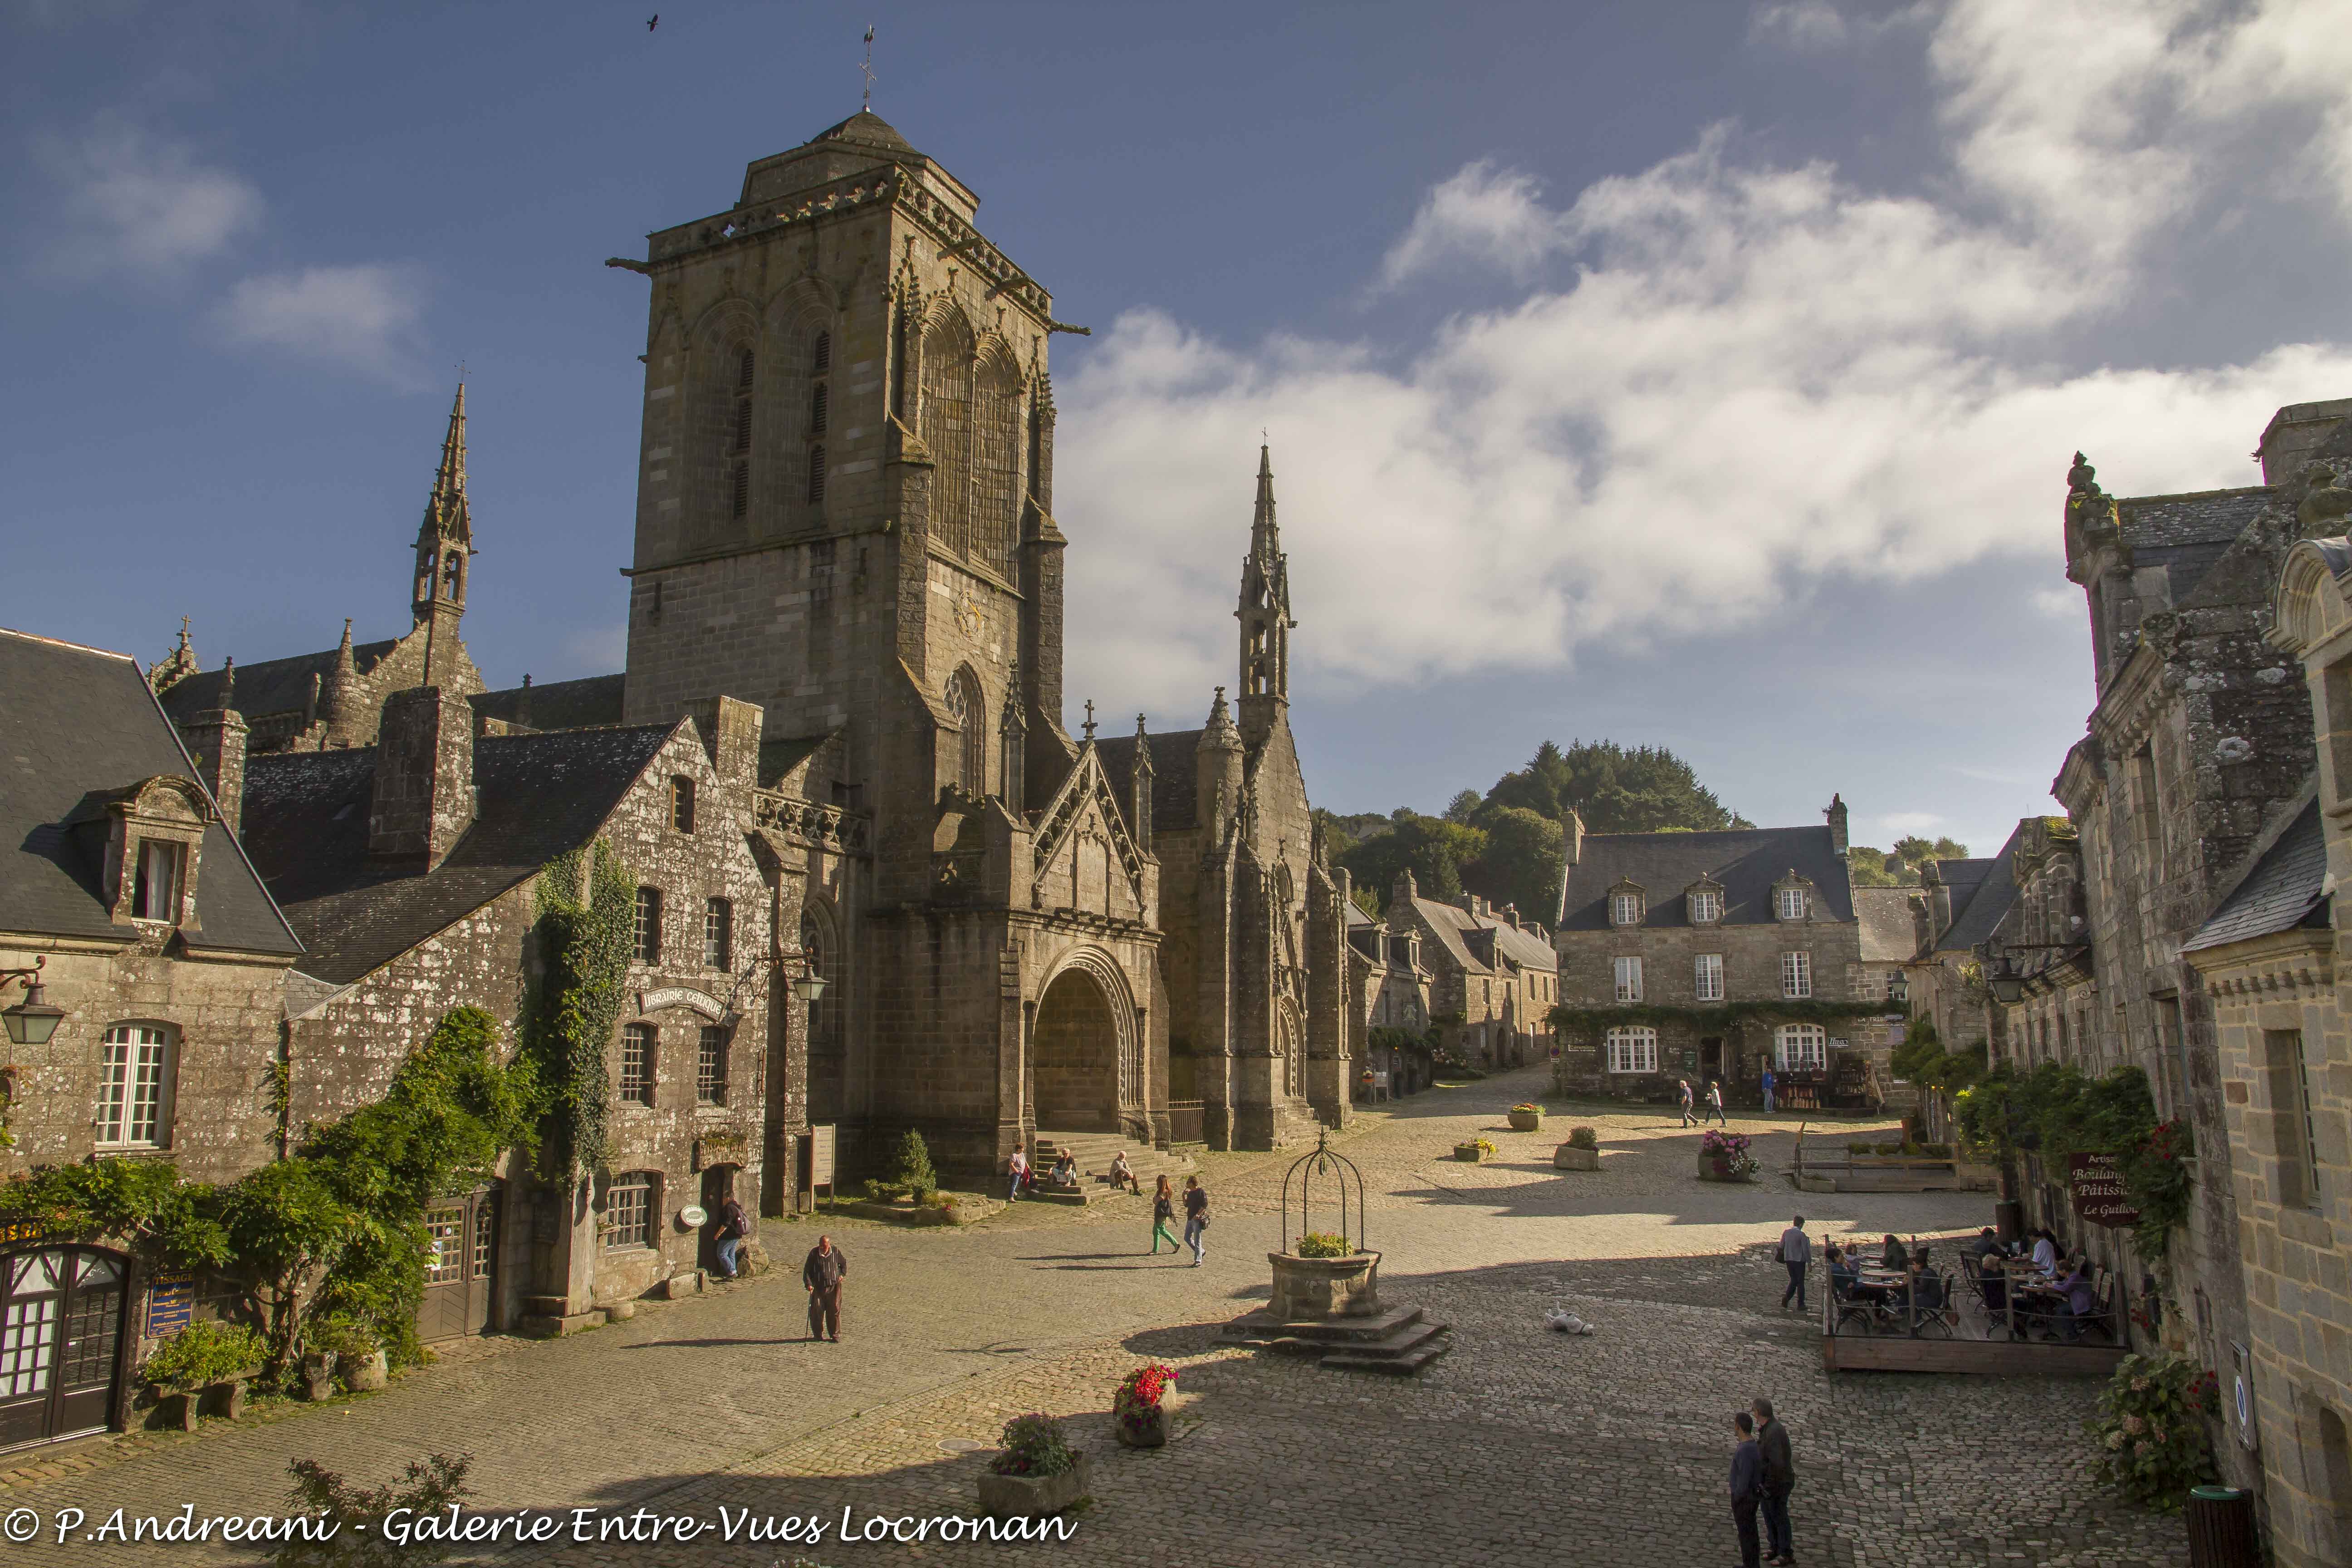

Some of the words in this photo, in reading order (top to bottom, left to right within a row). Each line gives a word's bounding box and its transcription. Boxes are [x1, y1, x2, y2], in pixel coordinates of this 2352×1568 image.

[2073, 1166, 2127, 1184] Boulang
[2083, 1205, 2097, 1214] Le
[155, 1273, 193, 1284] TISSAGE
